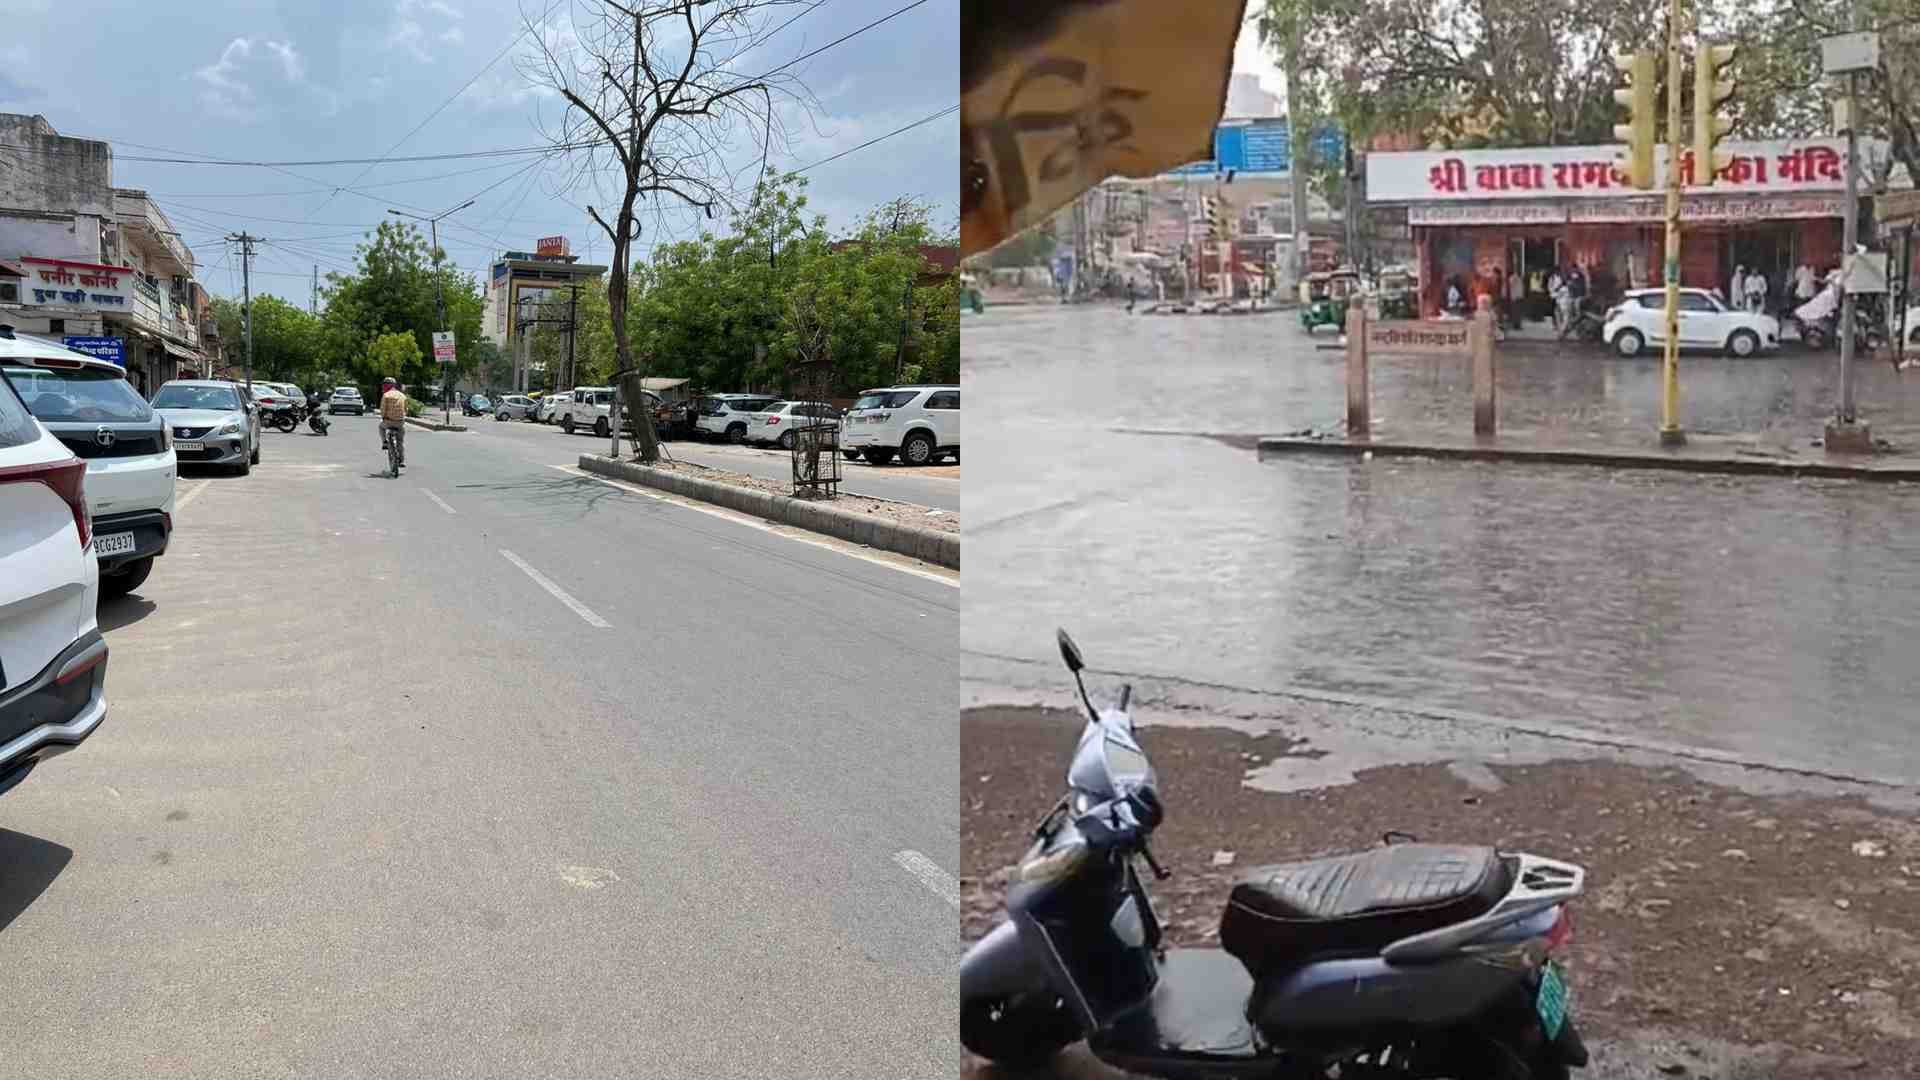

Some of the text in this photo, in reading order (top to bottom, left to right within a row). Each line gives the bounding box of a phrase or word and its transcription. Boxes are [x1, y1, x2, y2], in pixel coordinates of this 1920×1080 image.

[1427, 158, 1468, 192] श्री
[1475, 164, 1545, 190] बाबा
[38, 266, 75, 286] पनीर
